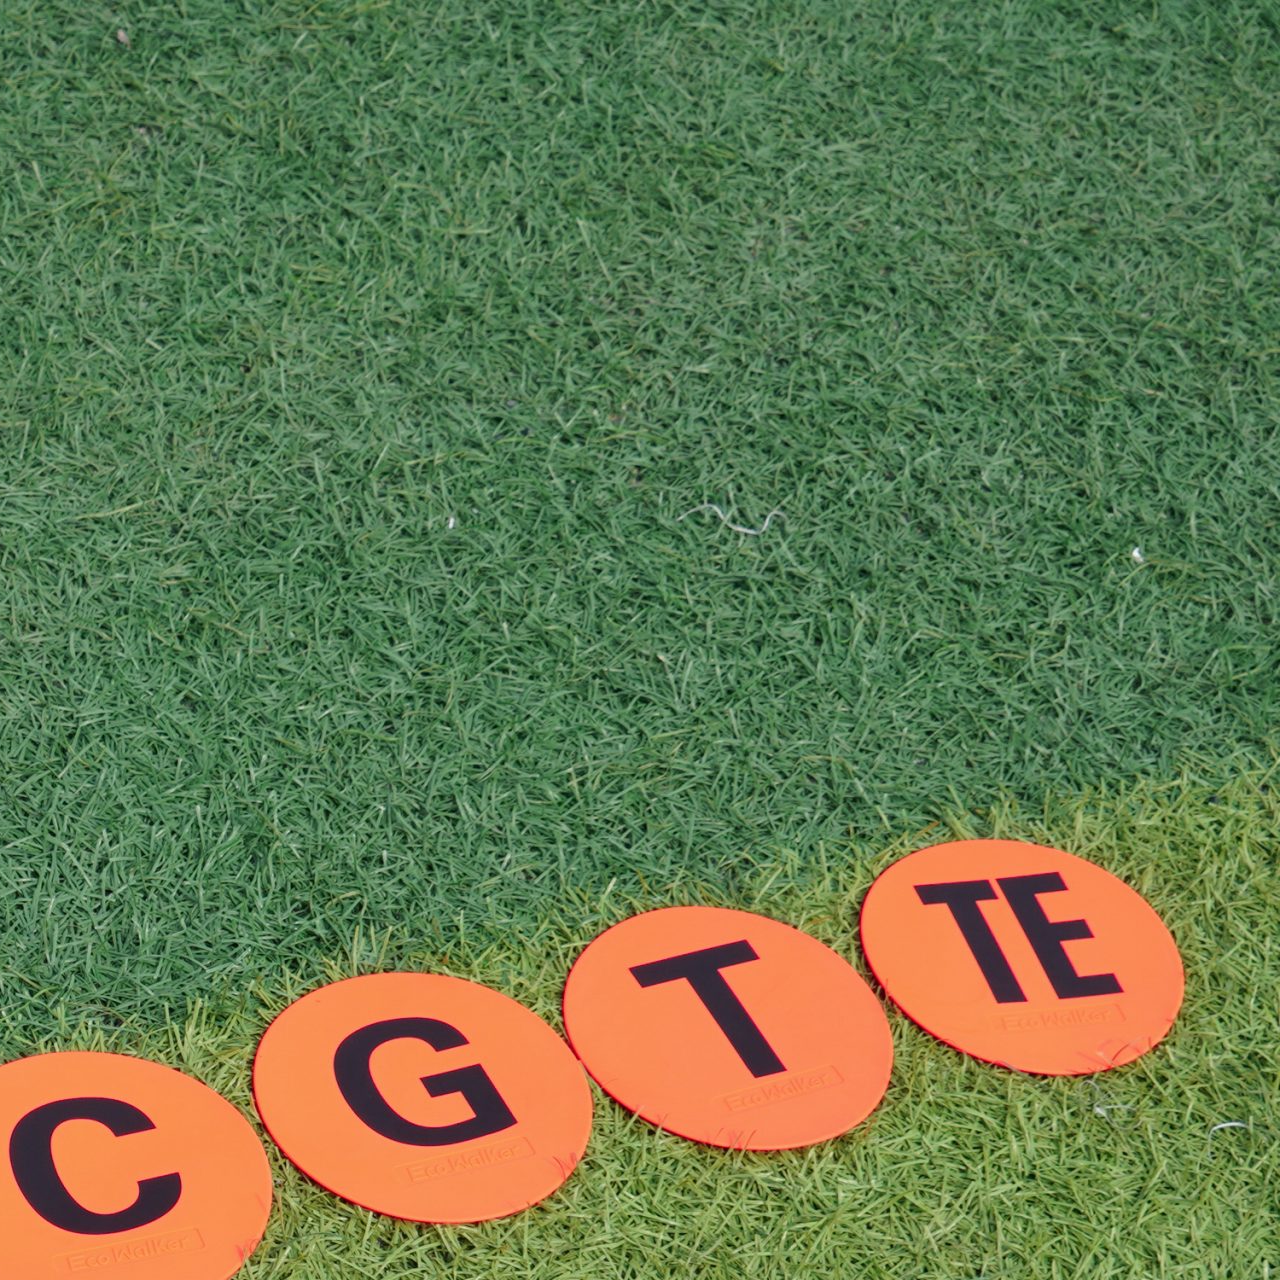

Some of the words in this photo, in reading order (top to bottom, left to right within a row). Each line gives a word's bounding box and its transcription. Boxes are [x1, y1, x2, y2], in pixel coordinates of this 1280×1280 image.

[916, 873, 1125, 1003] TE
[631, 941, 787, 1079] T
[333, 1018, 518, 1147] G
[9, 1097, 182, 1235] C
